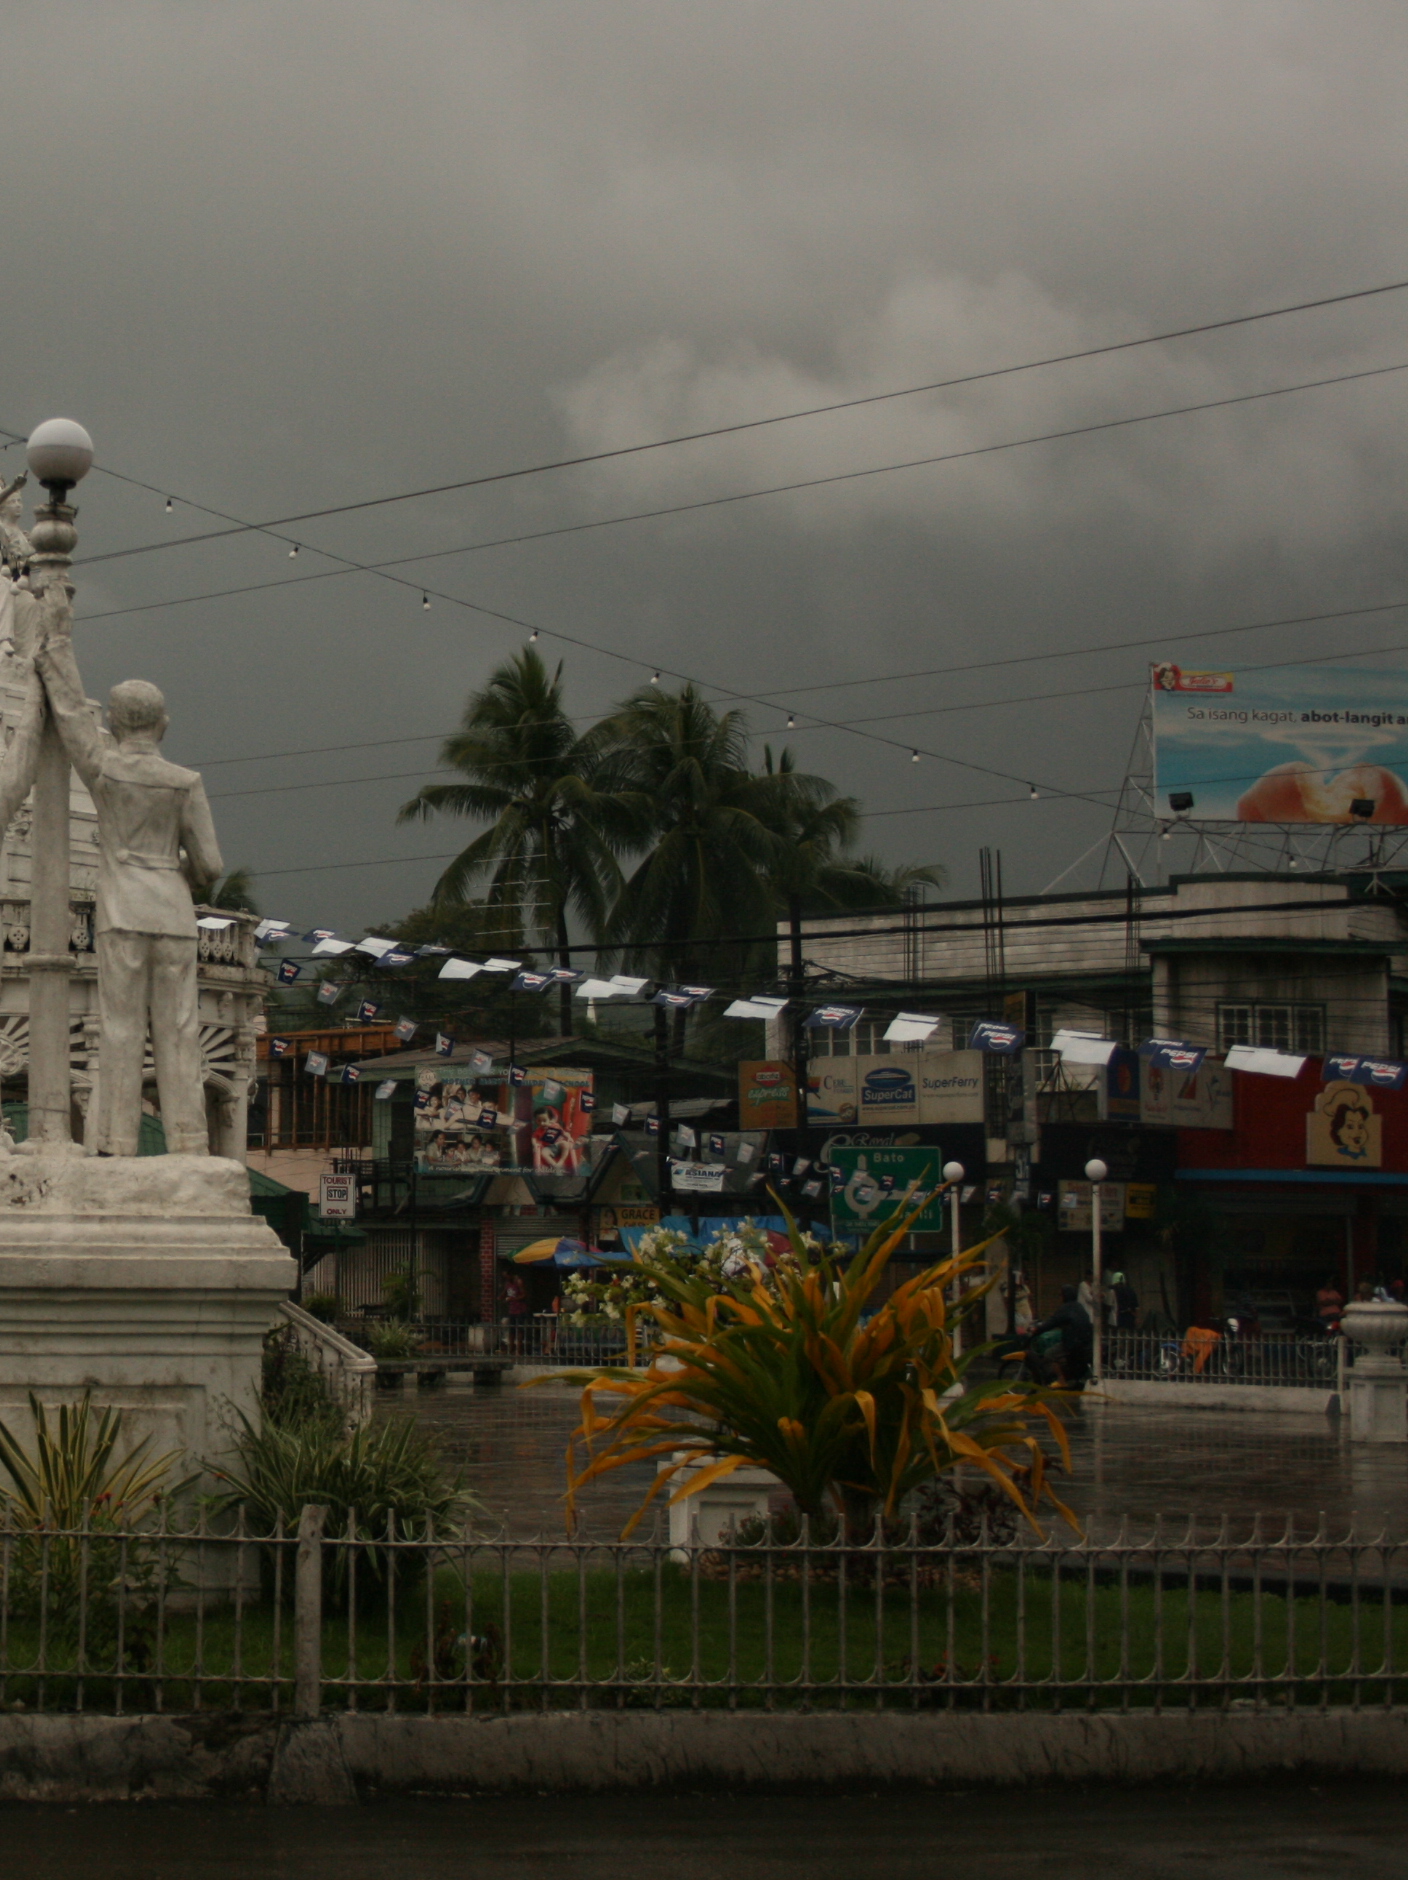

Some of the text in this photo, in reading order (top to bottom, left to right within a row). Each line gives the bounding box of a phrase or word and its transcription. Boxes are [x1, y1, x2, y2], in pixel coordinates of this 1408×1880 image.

[1187, 707, 1204, 719] Sa
[1208, 708, 1248, 723] isang
[1301, 710, 1393, 727] abot-langit
[1397, 715, 1408, 724] a
[981, 1030, 1016, 1040] PEPSI
[1160, 1048, 1199, 1058] PEPSI
[1361, 1061, 1402, 1072] PEPSI
[922, 1077, 979, 1090] SuperFerry
[864, 1088, 913, 1102] SuperCat
[873, 1152, 905, 1162] Bato
[323, 1176, 352, 1184] TOURIST
[328, 1189, 347, 1198] STOP
[621, 1208, 655, 1220] GRACE
